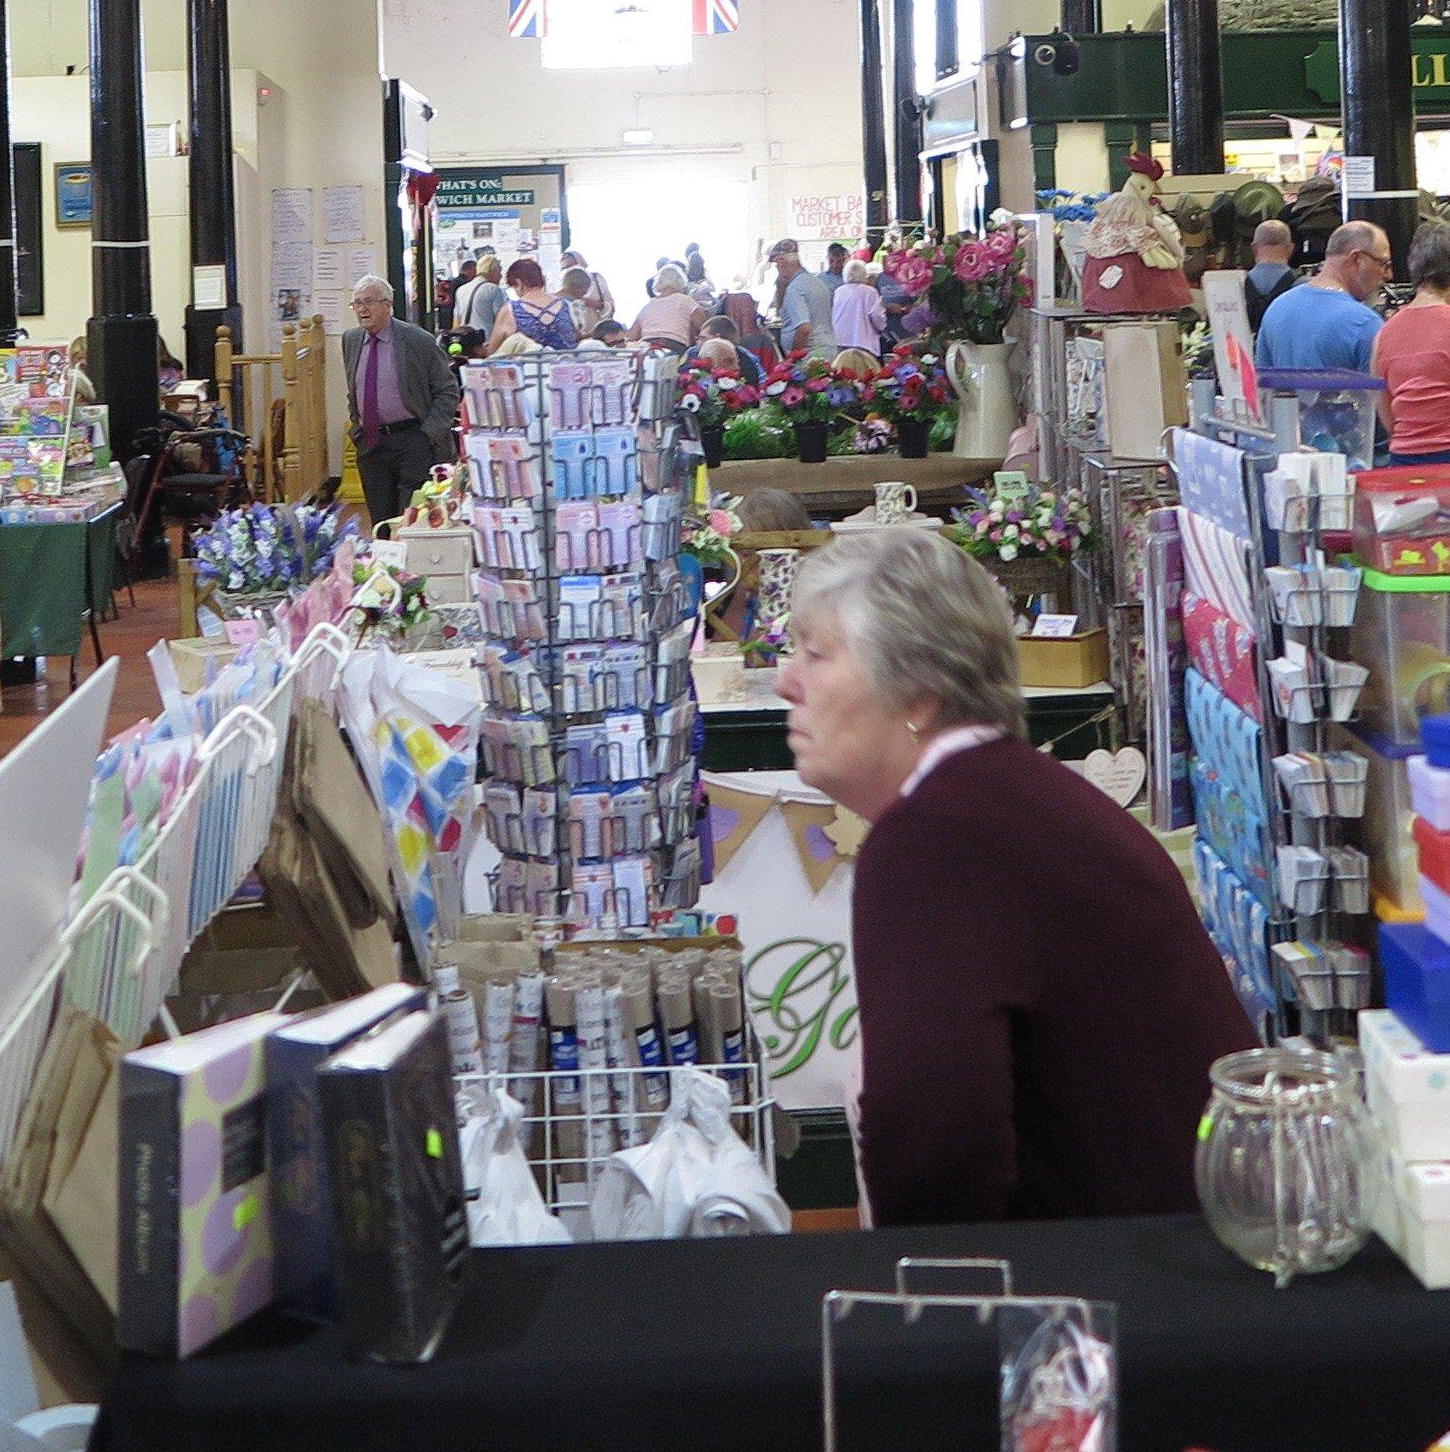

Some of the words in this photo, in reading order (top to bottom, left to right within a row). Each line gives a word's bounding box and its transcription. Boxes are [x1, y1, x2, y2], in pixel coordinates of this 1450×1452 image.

[476, 192, 532, 204] MARKET
[792, 196, 840, 211] MARKET
[796, 211, 851, 227] CUSTOMER
